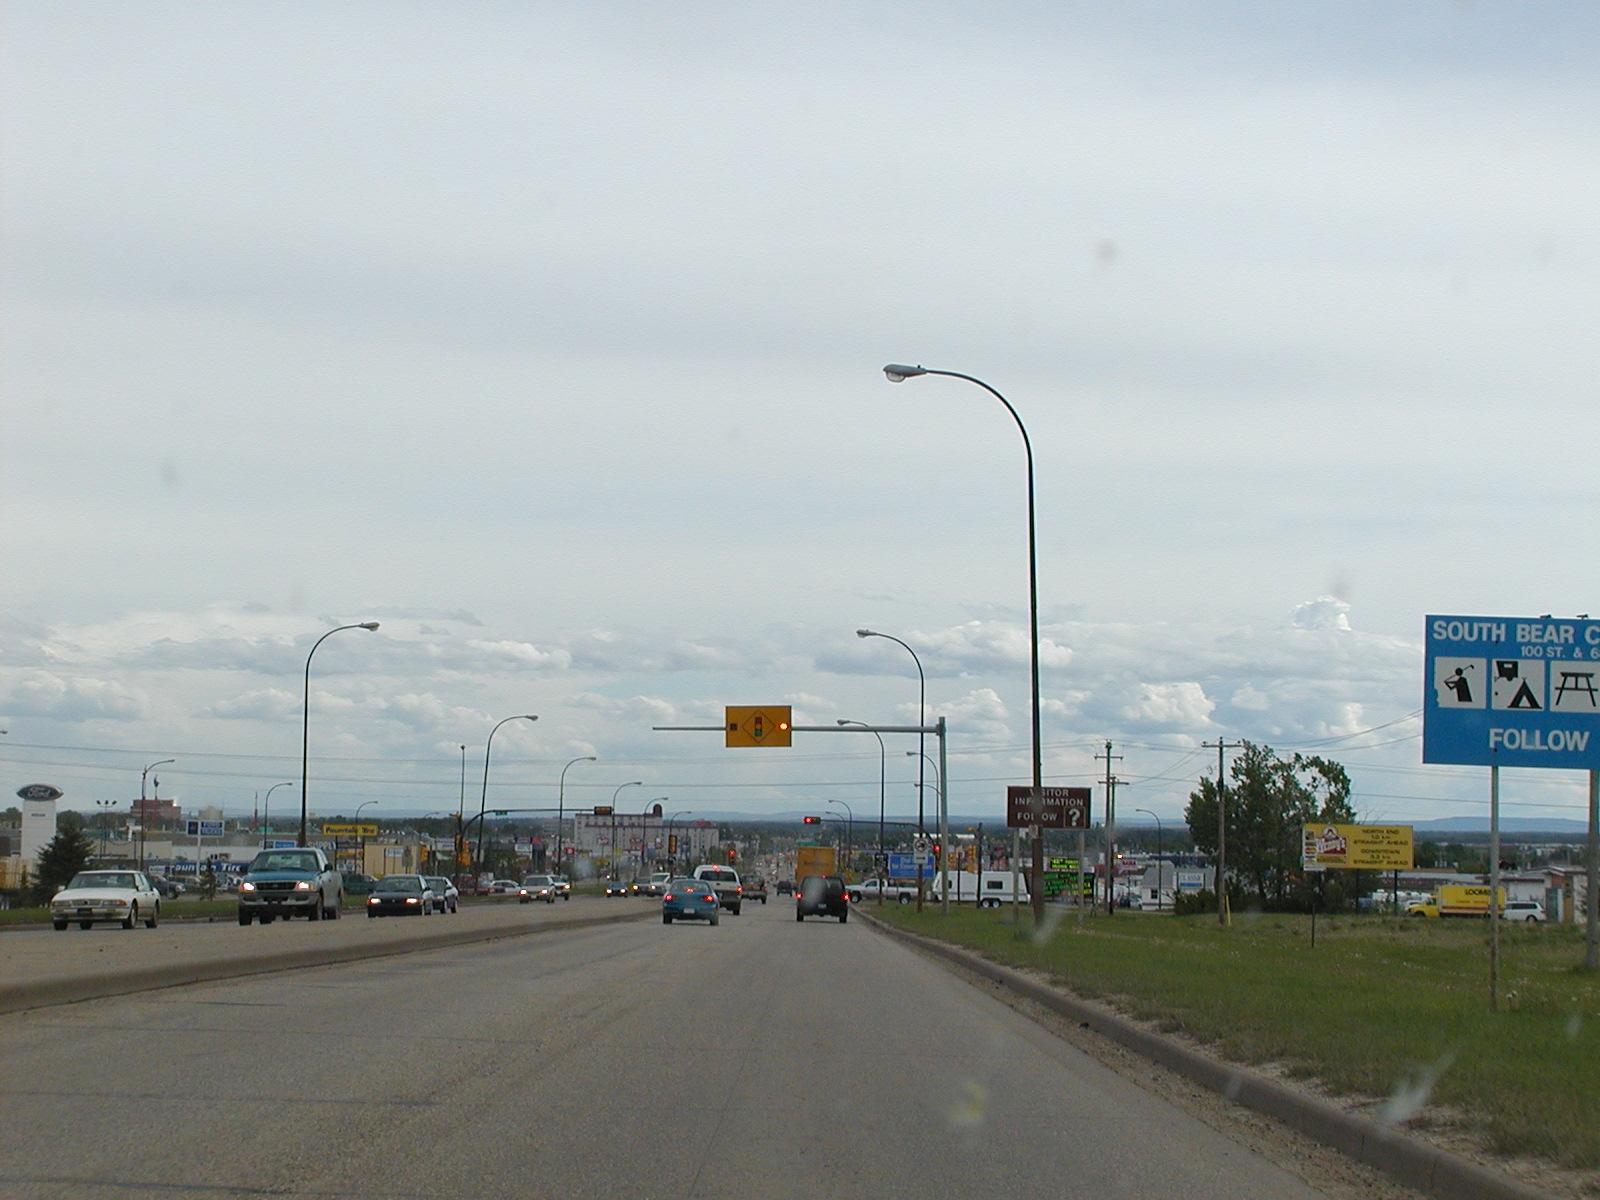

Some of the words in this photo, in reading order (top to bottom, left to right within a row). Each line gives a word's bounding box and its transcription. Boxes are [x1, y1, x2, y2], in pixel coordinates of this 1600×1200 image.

[1434, 621, 1505, 642] SOUTH
[1515, 624, 1575, 644] BEAR
[1521, 645, 1543, 658] 100
[1546, 646, 1566, 658] ST.
[1590, 647, 1600, 659] 6
[1489, 728, 1590, 752] FOLLOW
[1029, 788, 1070, 797] VSITOR
[1014, 797, 1084, 807] INFRMATION
[1016, 812, 1058, 822] FOLOW
